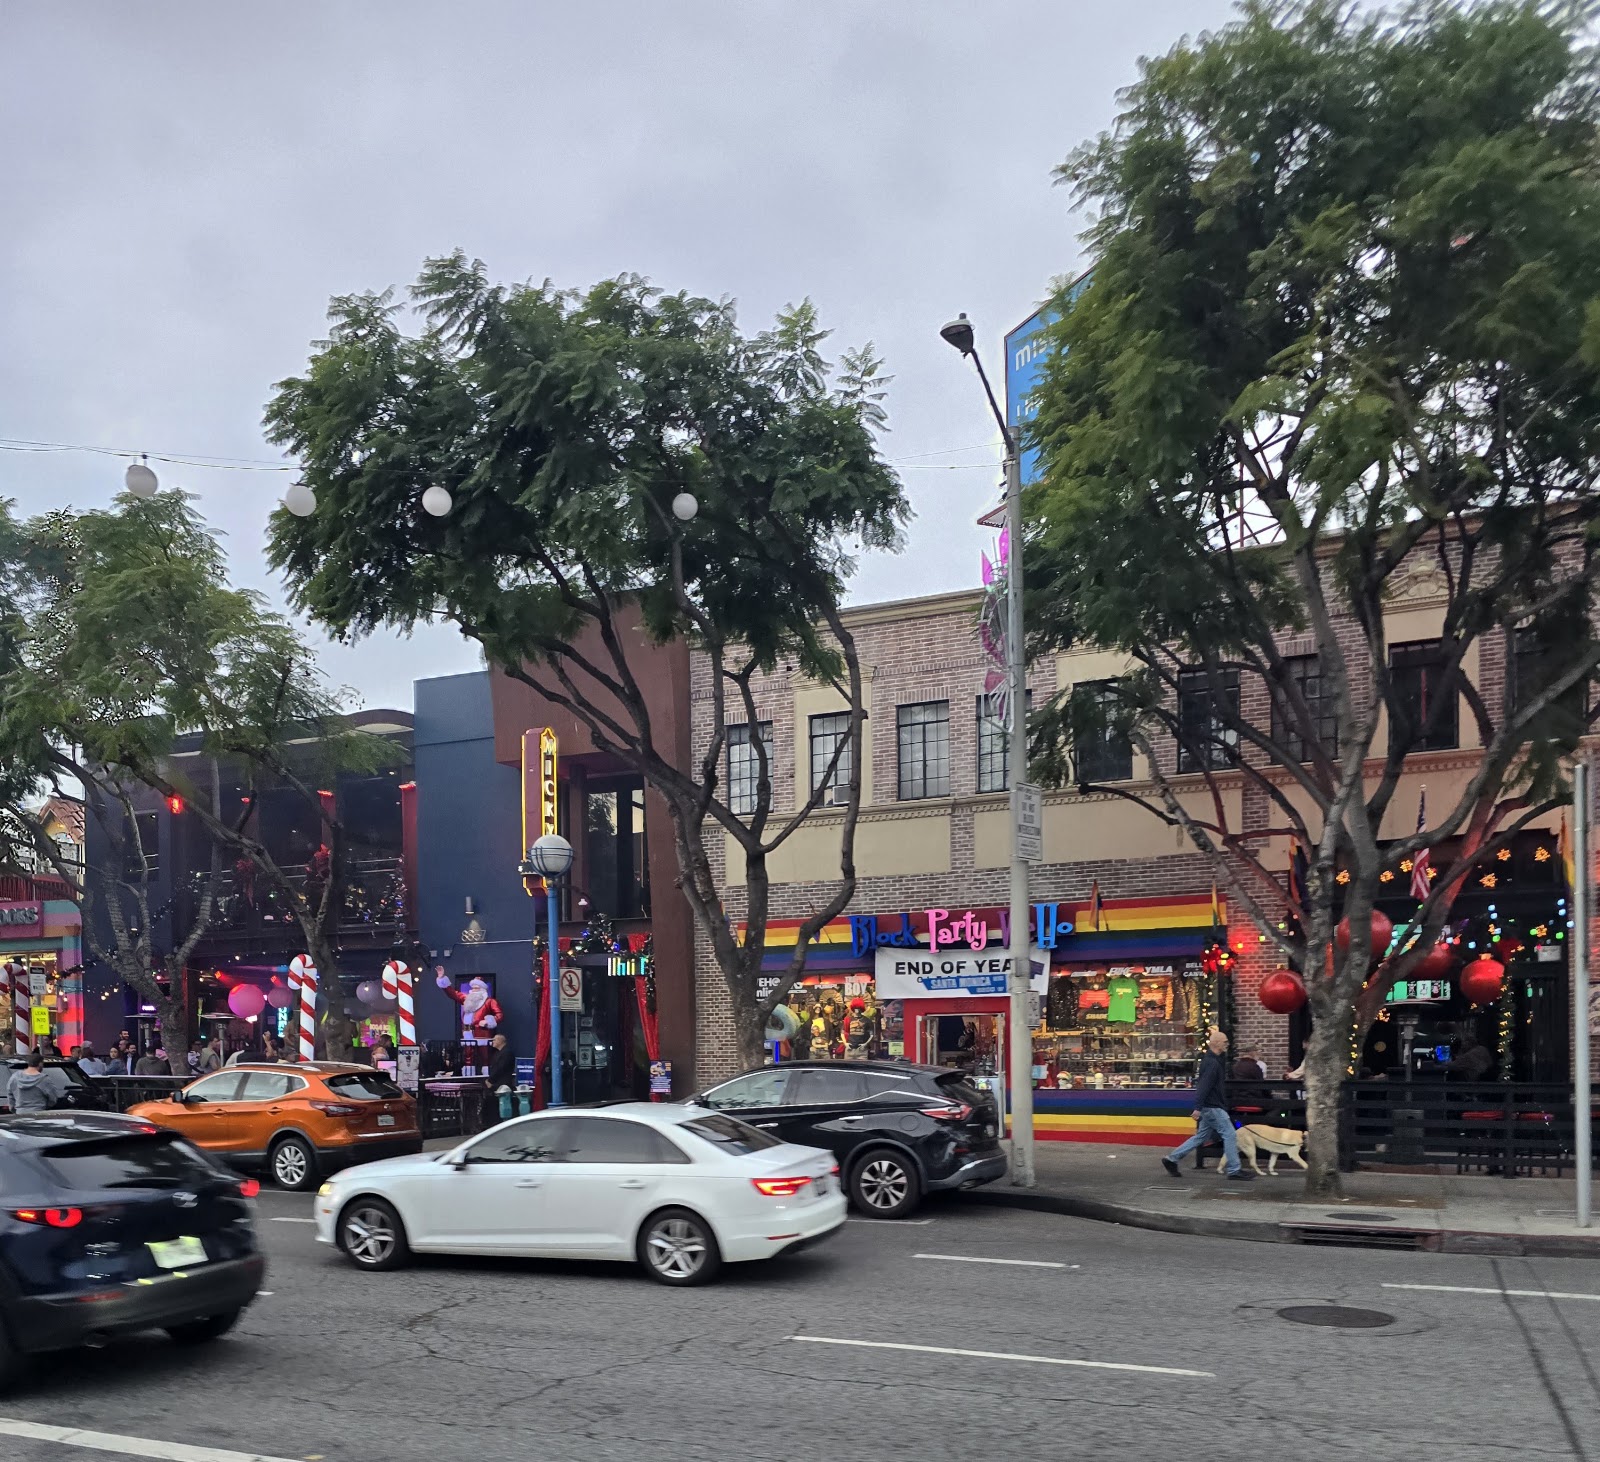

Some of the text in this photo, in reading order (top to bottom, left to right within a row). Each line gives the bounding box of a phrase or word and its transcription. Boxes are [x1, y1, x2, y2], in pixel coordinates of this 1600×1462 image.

[848, 912, 921, 957] Block
[924, 908, 987, 954] Party
[894, 958, 1012, 975] END OF YEA
